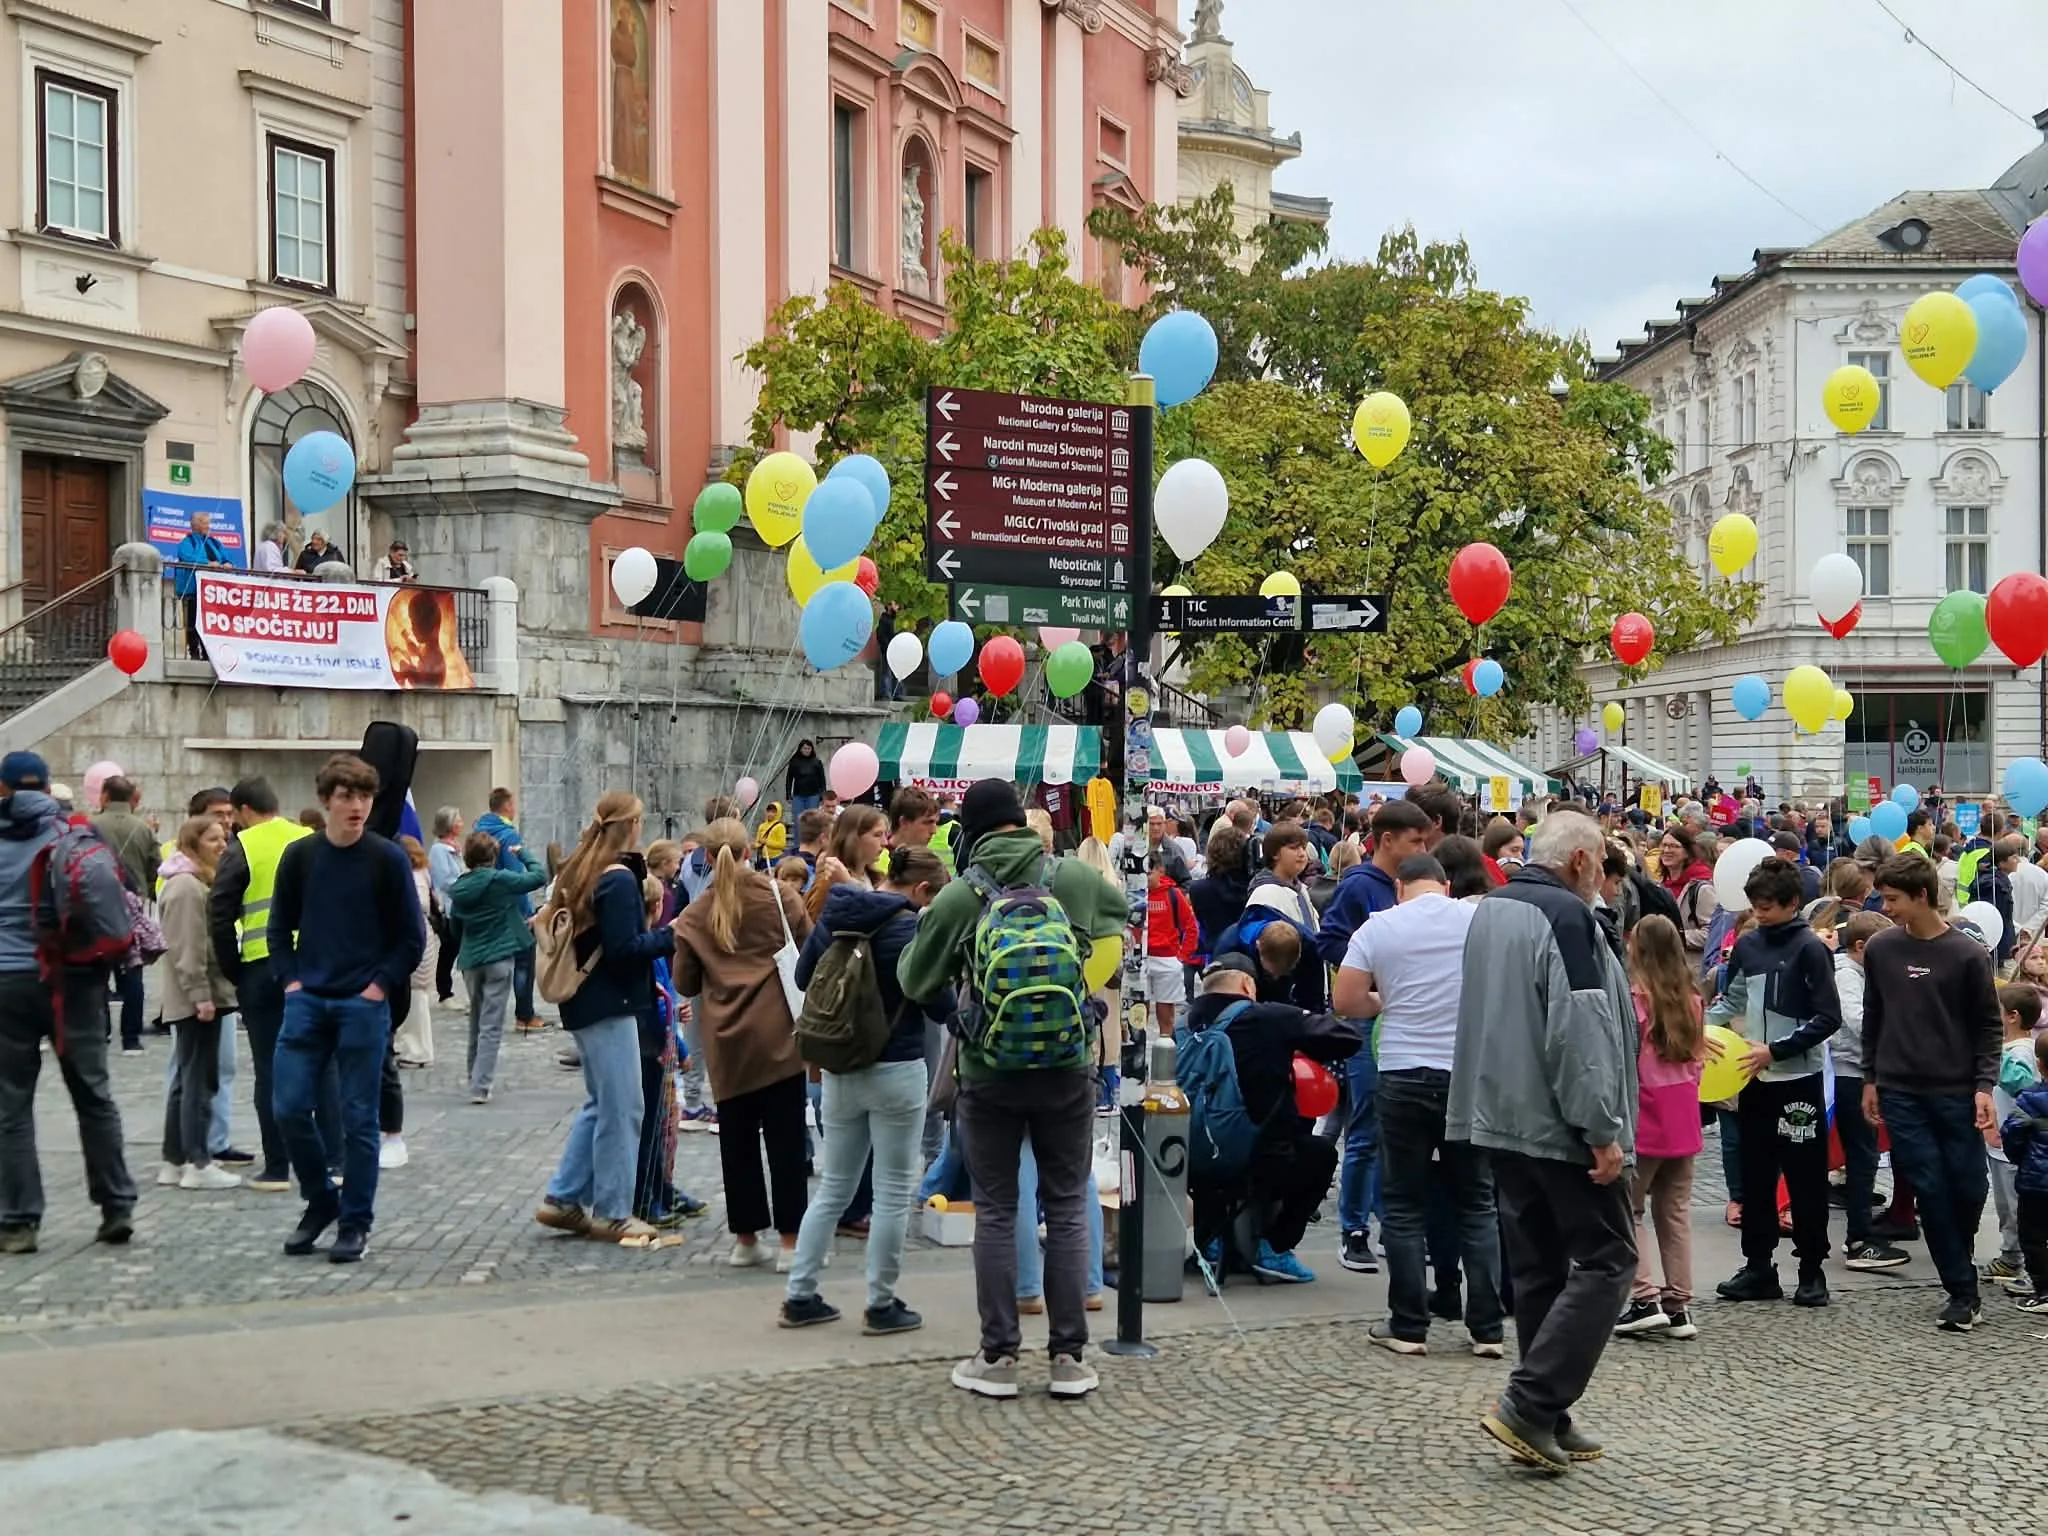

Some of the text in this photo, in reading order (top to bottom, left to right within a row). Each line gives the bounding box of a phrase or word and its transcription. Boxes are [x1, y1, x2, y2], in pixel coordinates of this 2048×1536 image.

[1021, 400, 1103, 422] Narodna galerija
[998, 416, 1103, 435] National Gallery of Slovenia
[983, 436, 1103, 460] Narodni muzej Slovenije
[1027, 457, 1060, 469] Museum
[1061, 460, 1070, 470] of
[1071, 460, 1103, 473] Slovenia
[992, 476, 1102, 498] MG+ Moderna galerija
[1012, 495, 1102, 511] Museum of Modern Art
[1081, 521, 1103, 535] grad
[971, 530, 1103, 549] International Centre of Graphic Arts
[1049, 557, 1102, 572] Nebotičnik
[1060, 575, 1102, 587] Skyscraper
[204, 584, 374, 615] SRCE BIJE ŽE 22. DAN
[1062, 595, 1107, 609] Park Tivoli
[1187, 601, 1207, 612] TIC
[205, 612, 334, 640] PO SPOČETJU!
[1072, 613, 1106, 625] Tivoli Park
[1187, 617, 1217, 627] Tourist
[1219, 617, 1271, 627] Information
